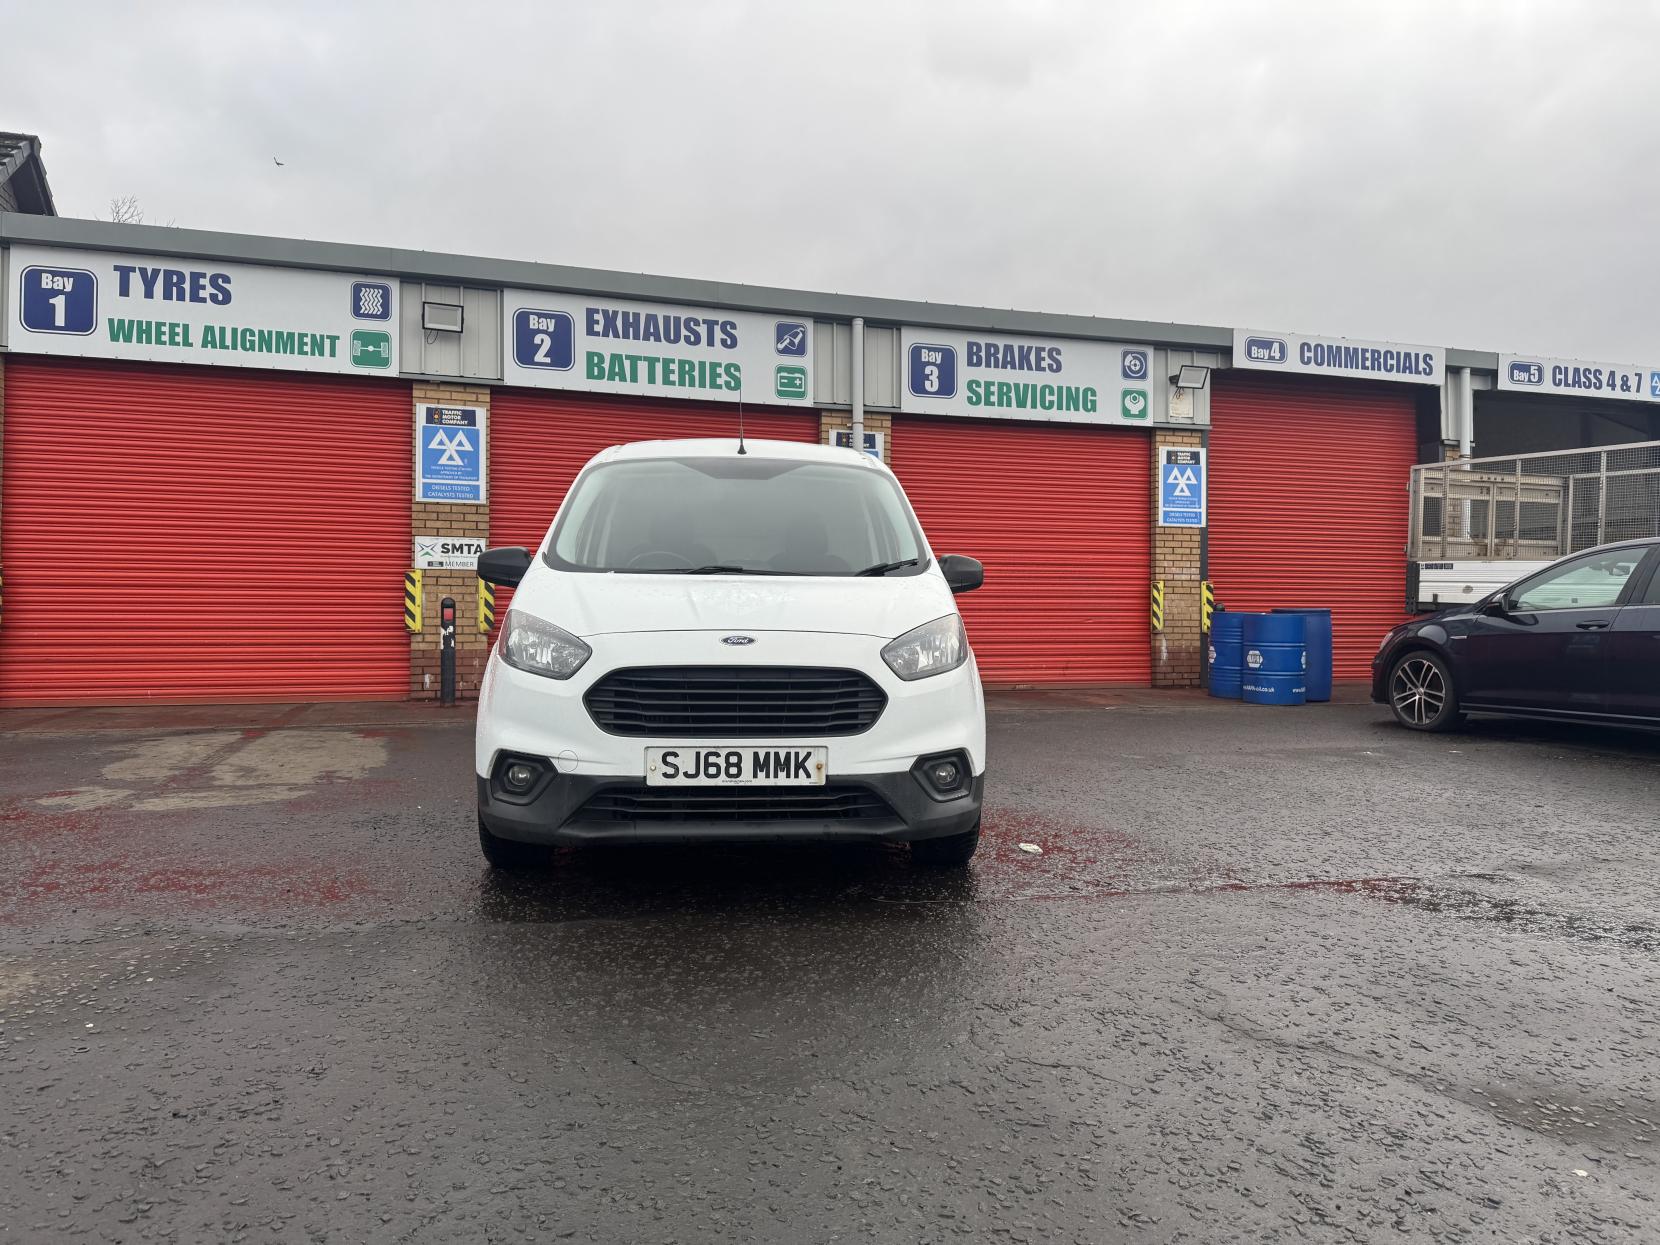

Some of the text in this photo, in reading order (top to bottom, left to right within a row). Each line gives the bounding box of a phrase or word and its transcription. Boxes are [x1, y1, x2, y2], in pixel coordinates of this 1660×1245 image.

[41, 273, 73, 293] Bay
[113, 264, 232, 306] TYRES
[48, 294, 66, 327] 1
[529, 314, 555, 333] Bay
[107, 318, 340, 358] WHEEL ALIGNMENT
[585, 307, 738, 350] EXHAUSTS
[533, 333, 551, 363] 2
[921, 348, 942, 365] Bay
[966, 341, 1063, 374] BRAKES
[1251, 342, 1281, 360] Bay 4
[1300, 341, 1434, 376] COMMERCIALS
[585, 350, 742, 392] BATTERIES
[924, 365, 939, 393] 3
[1513, 365, 1539, 383] Bay 5
[1552, 365, 1643, 393] CLASS 4 & 7
[966, 379, 1097, 413] SERVICING
[440, 543, 483, 555] SMTA
[726, 636, 750, 645] Ford
[661, 751, 812, 779] SJ68 MMK
